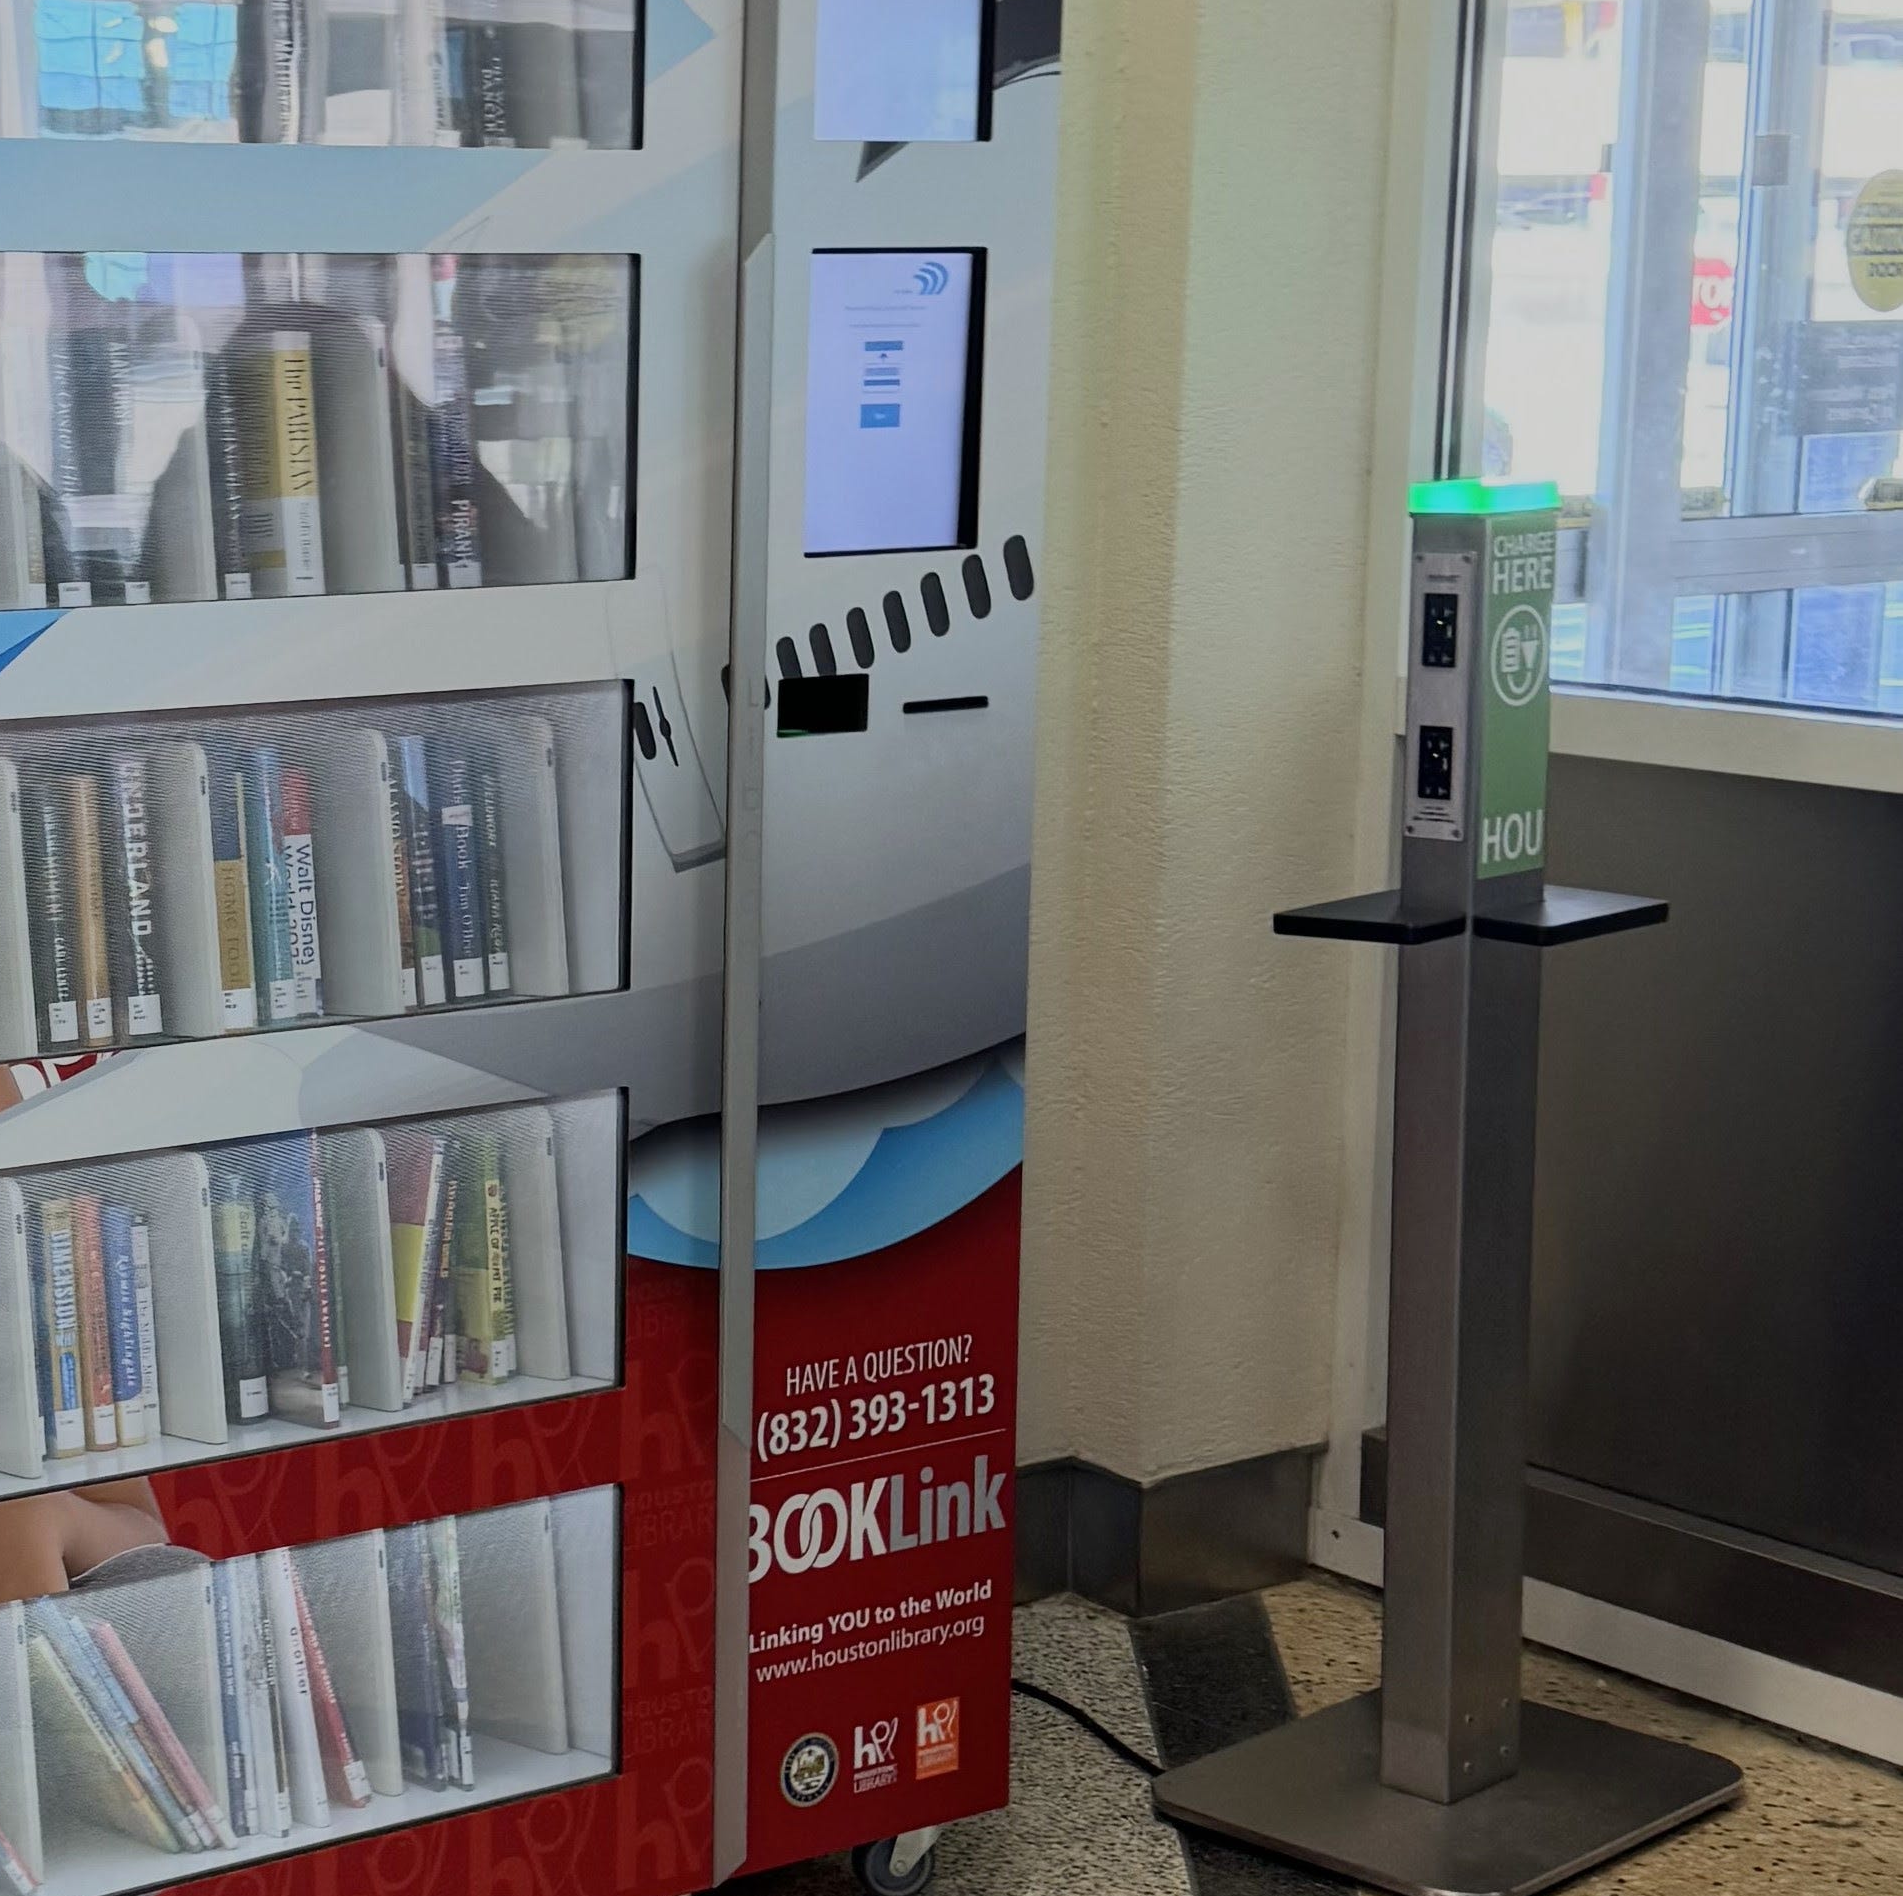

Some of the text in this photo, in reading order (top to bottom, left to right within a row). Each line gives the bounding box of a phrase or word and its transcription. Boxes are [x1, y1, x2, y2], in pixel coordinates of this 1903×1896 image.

[1492, 556, 1552, 595] HERE
[1493, 531, 1555, 559] CHARGE
[119, 762, 153, 936] UNDERLAND
[297, 844, 312, 893] Walt
[456, 825, 472, 869] Book
[1481, 808, 1543, 865] HOU
[461, 914, 474, 957] O'Brie
[51, 1230, 77, 1330] DIMENSION
[119, 1308, 138, 1386] Nightingale
[785, 1333, 973, 1397] HAVE A QUESTION?
[756, 1372, 996, 1463] (832) 393-1313
[748, 1578, 992, 1654] Linking YOU to the World
[755, 1611, 986, 1684] www.houstonlibrary.org
[289, 1626, 309, 1697] another
